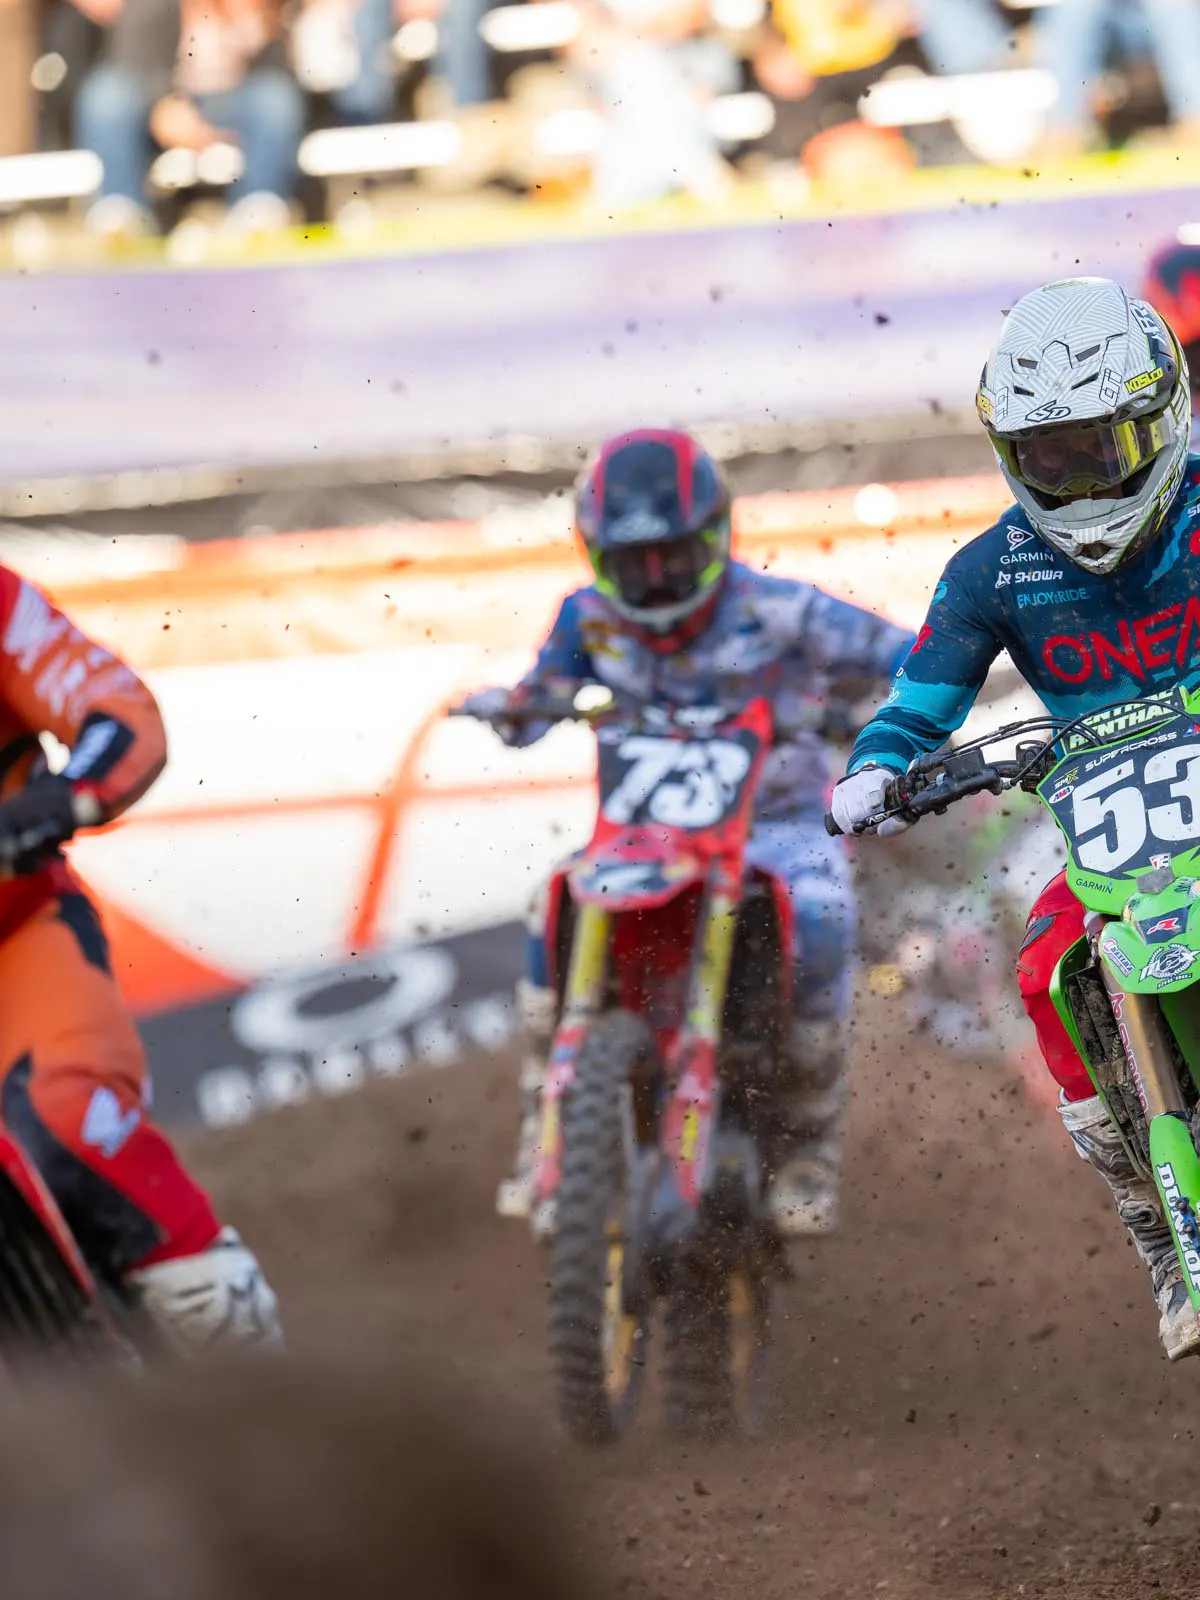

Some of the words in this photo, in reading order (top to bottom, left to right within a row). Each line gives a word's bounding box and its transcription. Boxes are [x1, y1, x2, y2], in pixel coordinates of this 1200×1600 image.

[1000, 551, 1055, 565] GARMIN
[1014, 569, 1064, 584] SHOWA
[1084, 731, 1178, 773] SUPERCROSS
[1075, 877, 1113, 895] GARMIN
